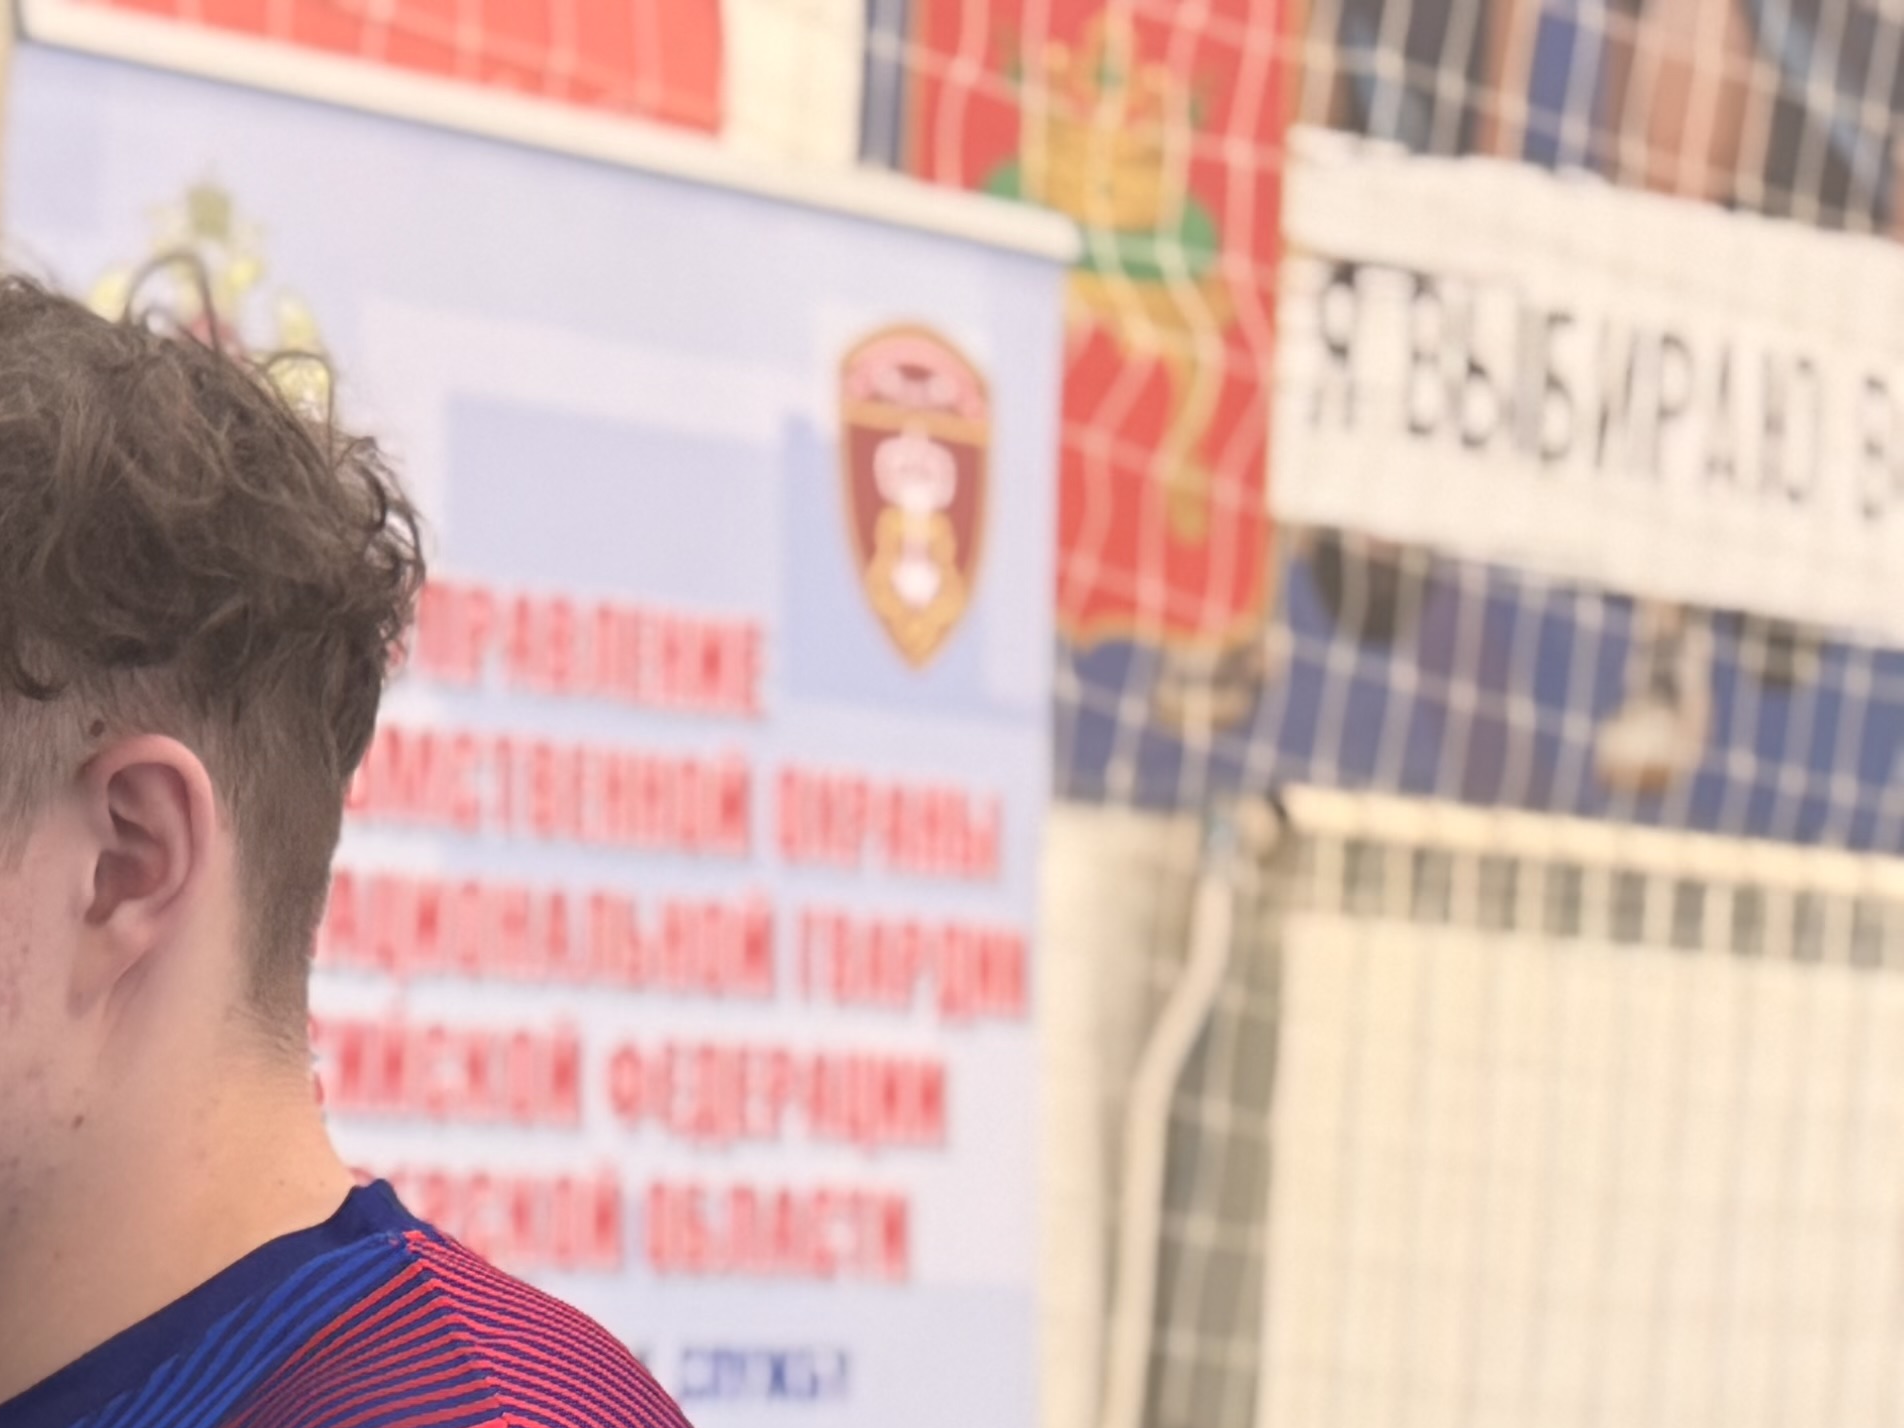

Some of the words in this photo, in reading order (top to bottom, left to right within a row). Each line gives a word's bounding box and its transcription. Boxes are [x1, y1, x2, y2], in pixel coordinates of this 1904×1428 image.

[1312, 258, 1356, 430] Я
[387, 575, 764, 720] ПРАВЛЕНИЕ
[312, 862, 776, 1000] АЦИОНАЛЬНОЙ
[606, 1035, 949, 1155] ФЕДЕРАЦИИ
